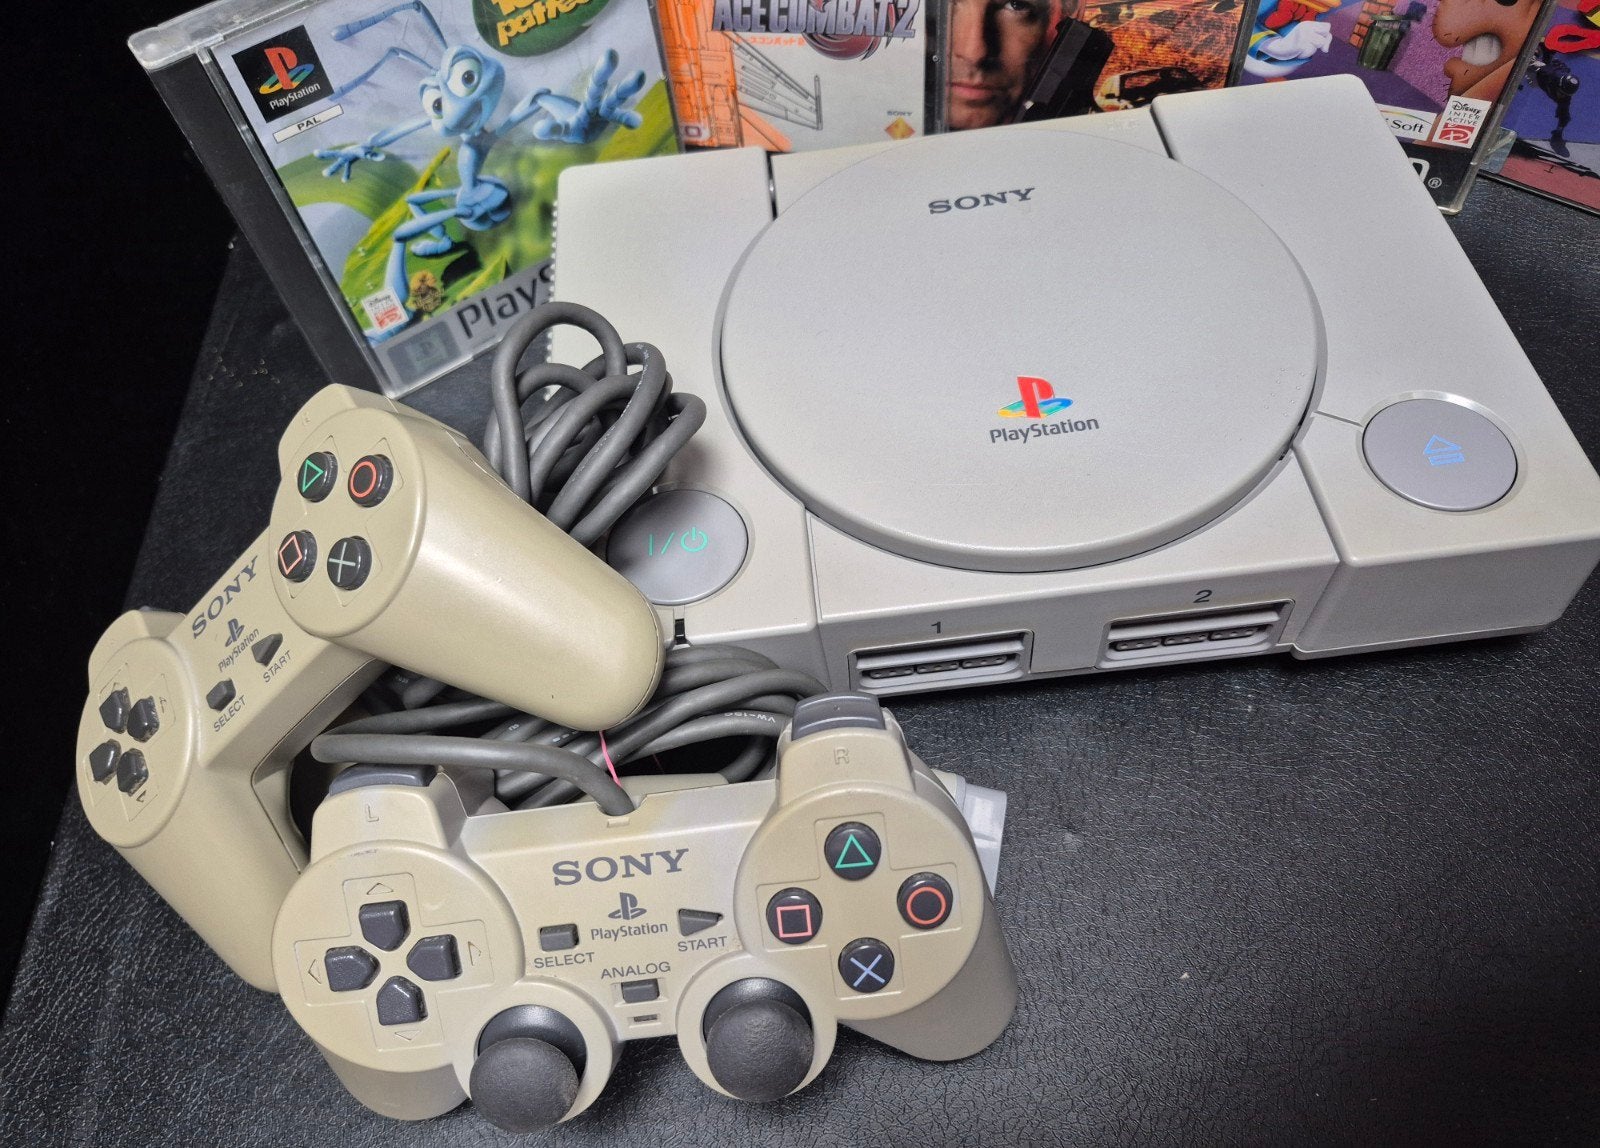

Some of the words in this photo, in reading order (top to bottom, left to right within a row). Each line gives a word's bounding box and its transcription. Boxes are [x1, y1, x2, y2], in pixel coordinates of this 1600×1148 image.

[496, 0, 591, 47] patte
[712, 0, 767, 32] ACE
[769, 0, 889, 36] COMBAT
[892, 0, 920, 38] 2
[269, 83, 321, 110] PlayStation
[297, 117, 321, 131] PAL
[1390, 119, 1425, 133] Soft
[1447, 117, 1478, 126] ACTIVE
[928, 187, 1036, 215] SONY
[989, 418, 1100, 444] PlayStation
[192, 555, 258, 640] SONY
[1192, 589, 1213, 604] 2
[930, 621, 942, 634] 1
[218, 628, 260, 673] PlayStation
[262, 650, 292, 684] START
[213, 695, 247, 733] SELECT
[833, 746, 850, 765] R
[364, 803, 380, 823] L
[552, 848, 690, 886] SONY
[591, 922, 668, 942] PlayStation
[677, 936, 728, 952] START
[534, 952, 596, 969] SELECT
[600, 961, 671, 979] ANALOG
